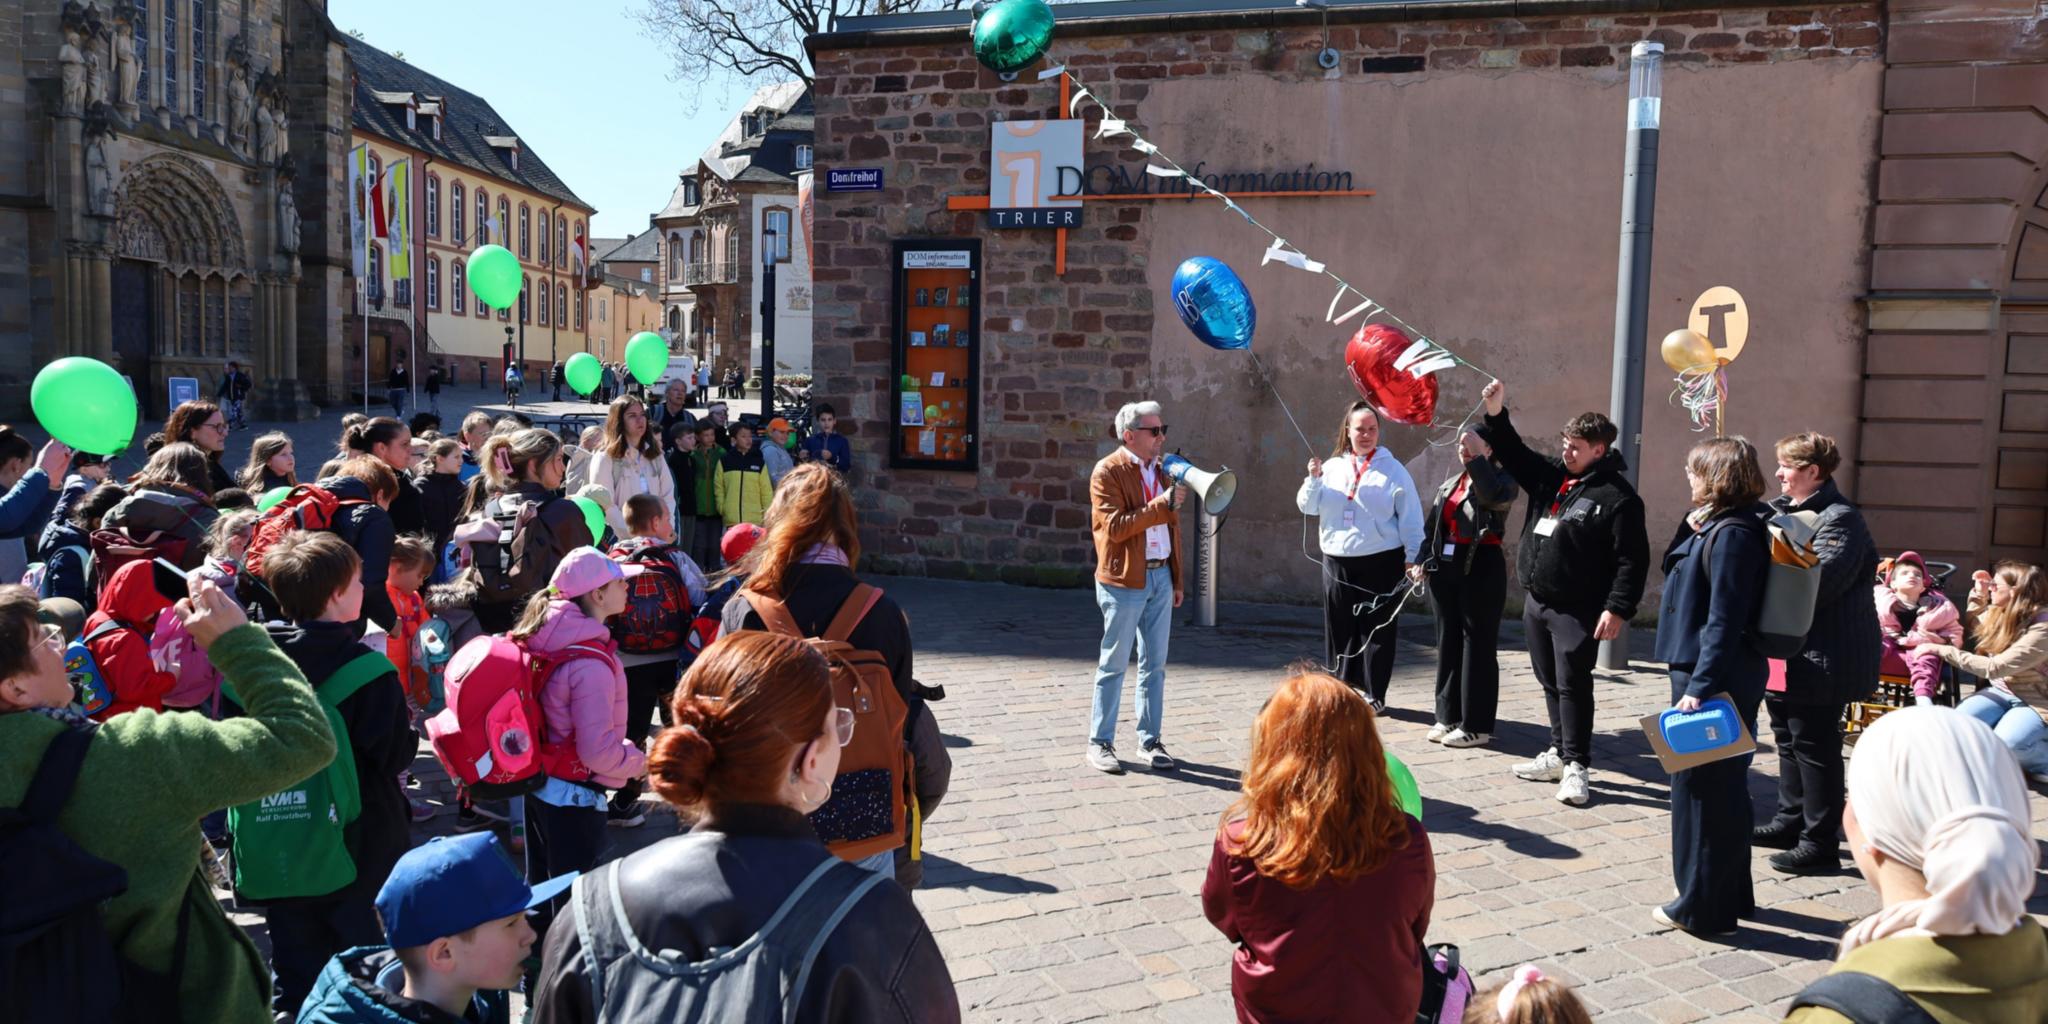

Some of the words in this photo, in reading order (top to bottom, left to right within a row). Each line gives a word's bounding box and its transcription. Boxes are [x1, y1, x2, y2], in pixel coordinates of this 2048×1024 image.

[832, 171, 878, 183] Domfreihof
[997, 211, 1073, 225] TRIER
[1700, 303, 1736, 349] T
[1200, 521, 1209, 597] TRINKWASSER
[261, 791, 293, 808] LVM
